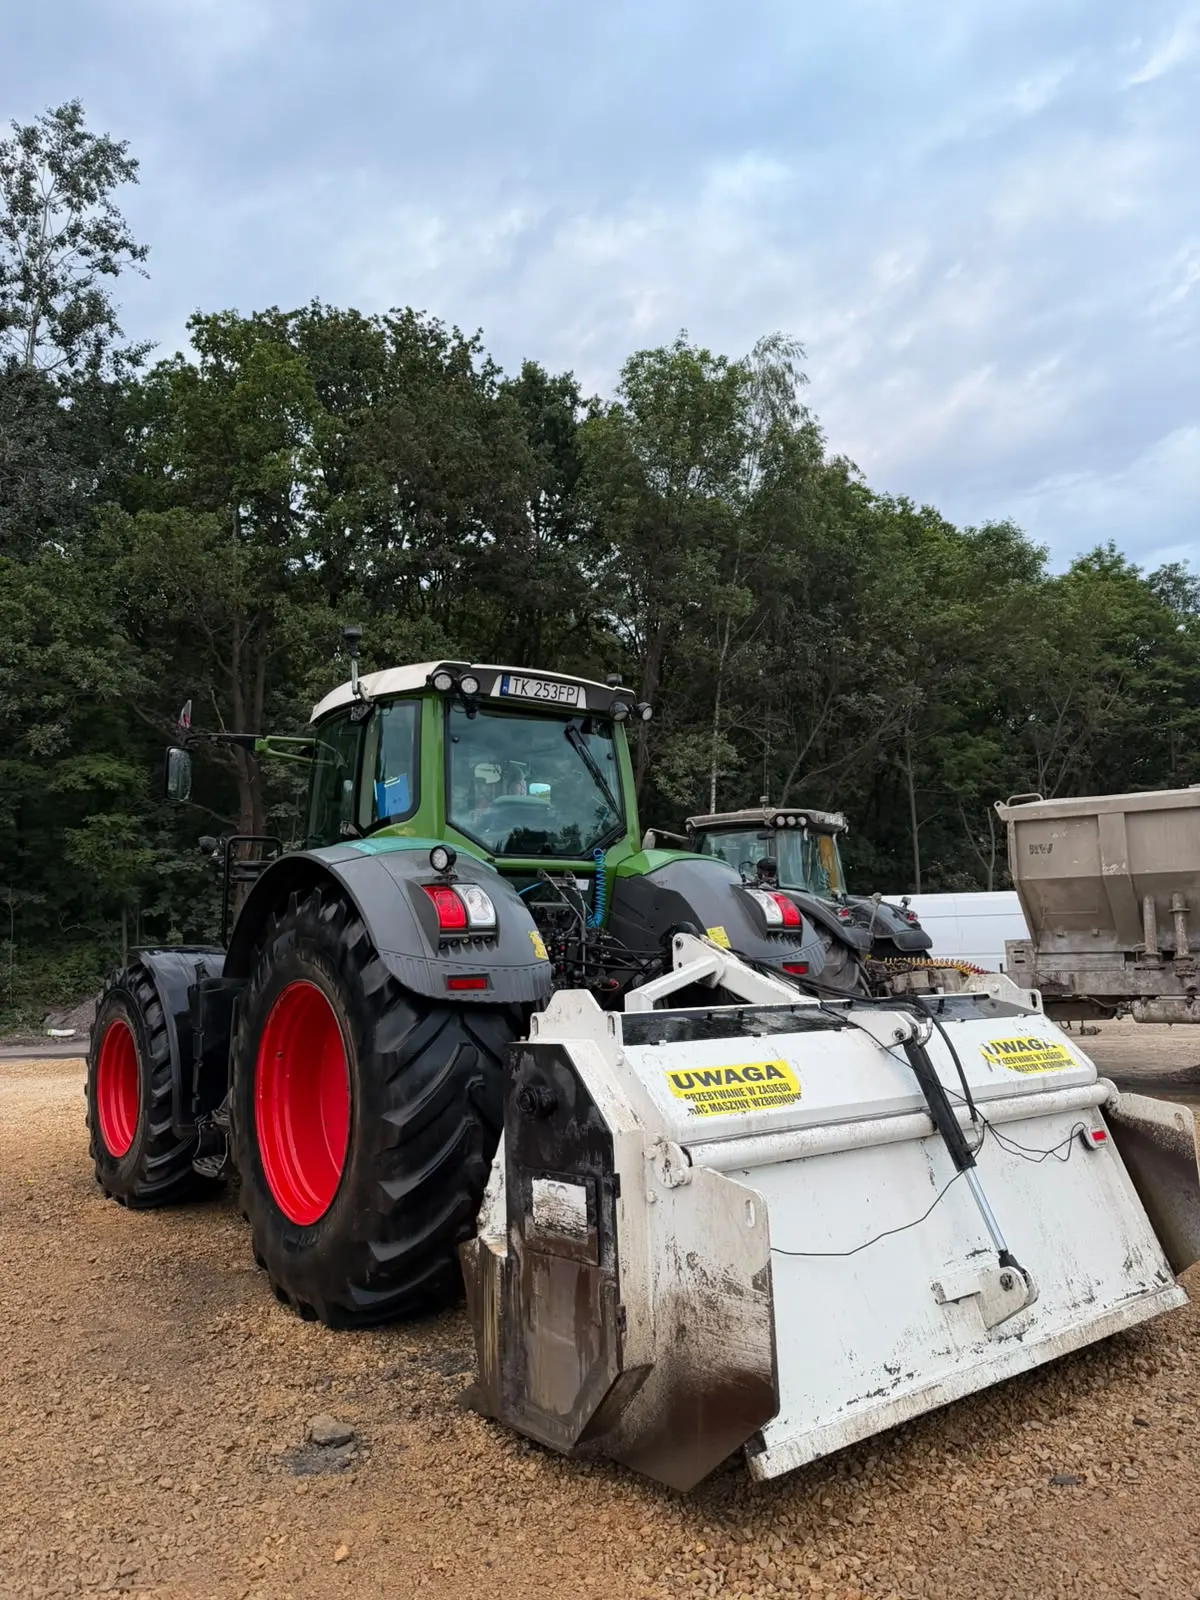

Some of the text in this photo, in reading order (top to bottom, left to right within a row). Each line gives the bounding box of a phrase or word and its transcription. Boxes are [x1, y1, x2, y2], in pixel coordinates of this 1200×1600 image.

[513, 678, 575, 701] TK 253FP
[671, 1064, 787, 1090] UWAGA
[684, 1082, 792, 1103] PRZEBYWANIE W ZASIĘGU
[708, 1098, 751, 1113] MASZYNY
[750, 1092, 802, 1107] WZBRONIONE
